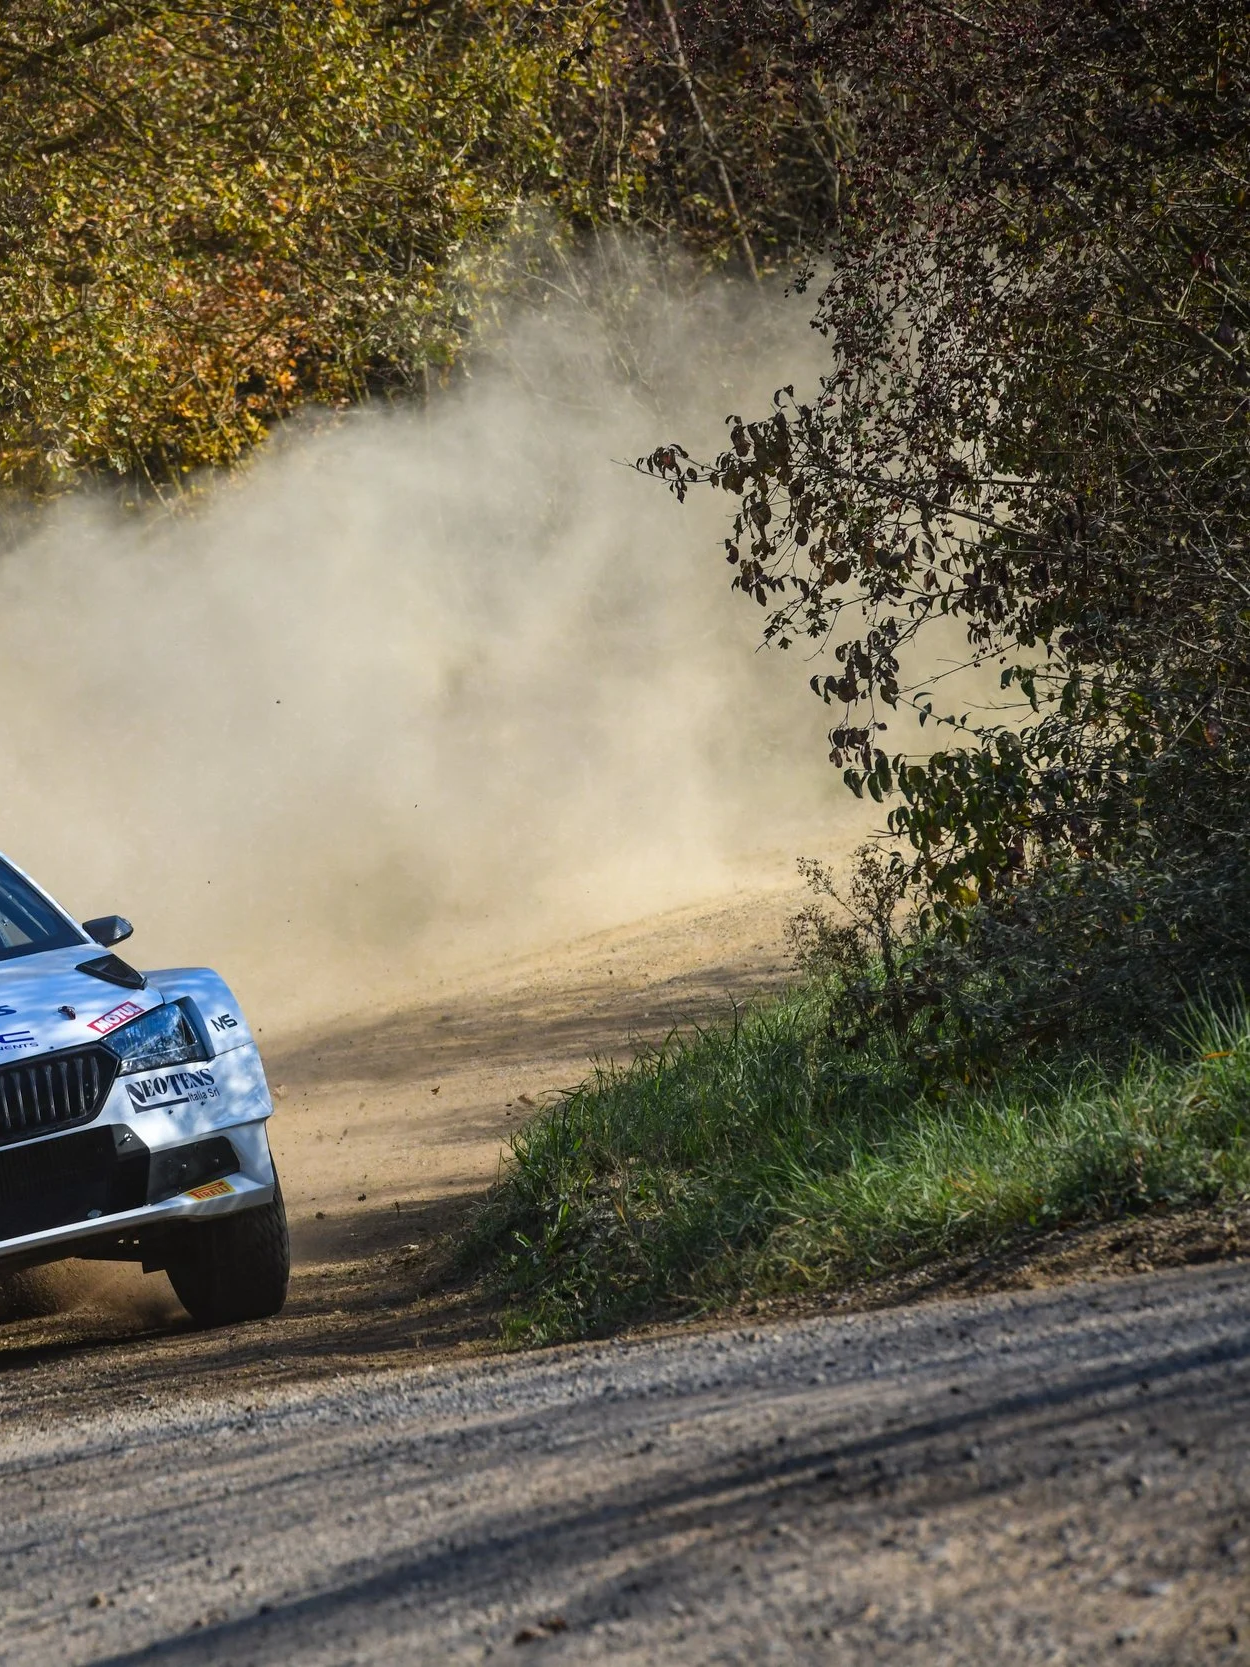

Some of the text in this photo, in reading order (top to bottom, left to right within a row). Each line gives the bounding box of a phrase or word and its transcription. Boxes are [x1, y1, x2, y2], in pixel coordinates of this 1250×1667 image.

[94, 1004, 140, 1032] MOTUL
[210, 1013, 238, 1032] MS
[125, 1068, 215, 1106] NEOTENS
[188, 1087, 220, 1102] Italia Srl
[190, 1182, 230, 1199] PIRELLI
